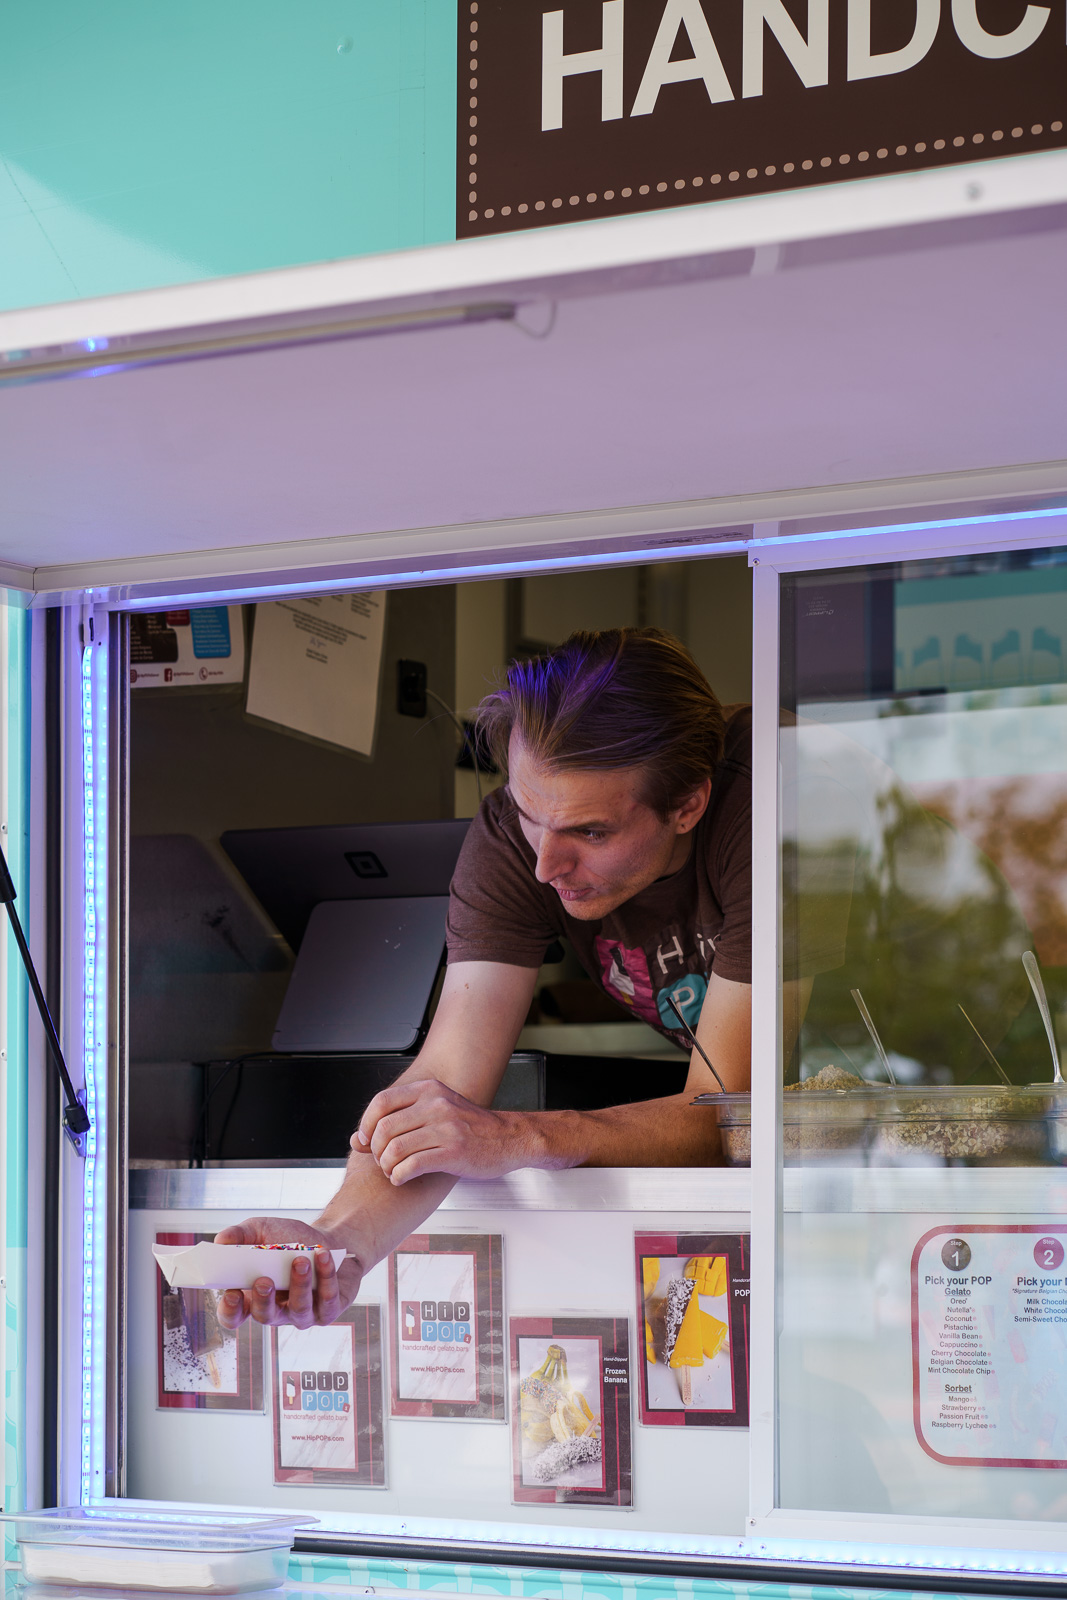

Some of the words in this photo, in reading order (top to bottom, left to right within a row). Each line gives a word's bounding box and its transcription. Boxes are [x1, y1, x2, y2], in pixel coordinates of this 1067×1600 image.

[542, 0, 1067, 131] HANDC
[951, 1250, 960, 1267] 1
[1043, 1249, 1055, 1266] 2
[925, 1276, 945, 1285] Pick
[946, 1278, 968, 1287] your
[971, 1276, 992, 1285] POP
[1017, 1277, 1038, 1286] Pick
[1040, 1279, 1062, 1288] your
[944, 1288, 971, 1296] Gelato
[424, 1304, 467, 1317] Hip
[939, 1341, 978, 1349] Cappuccino
[304, 1374, 346, 1390] Hip
[604, 1376, 628, 1384] Banana
[944, 1384, 972, 1393] Sorbet
[941, 1404, 977, 1412] Strawberry
[931, 1421, 964, 1429] Raspberry
[965, 1422, 989, 1430] Lychee
